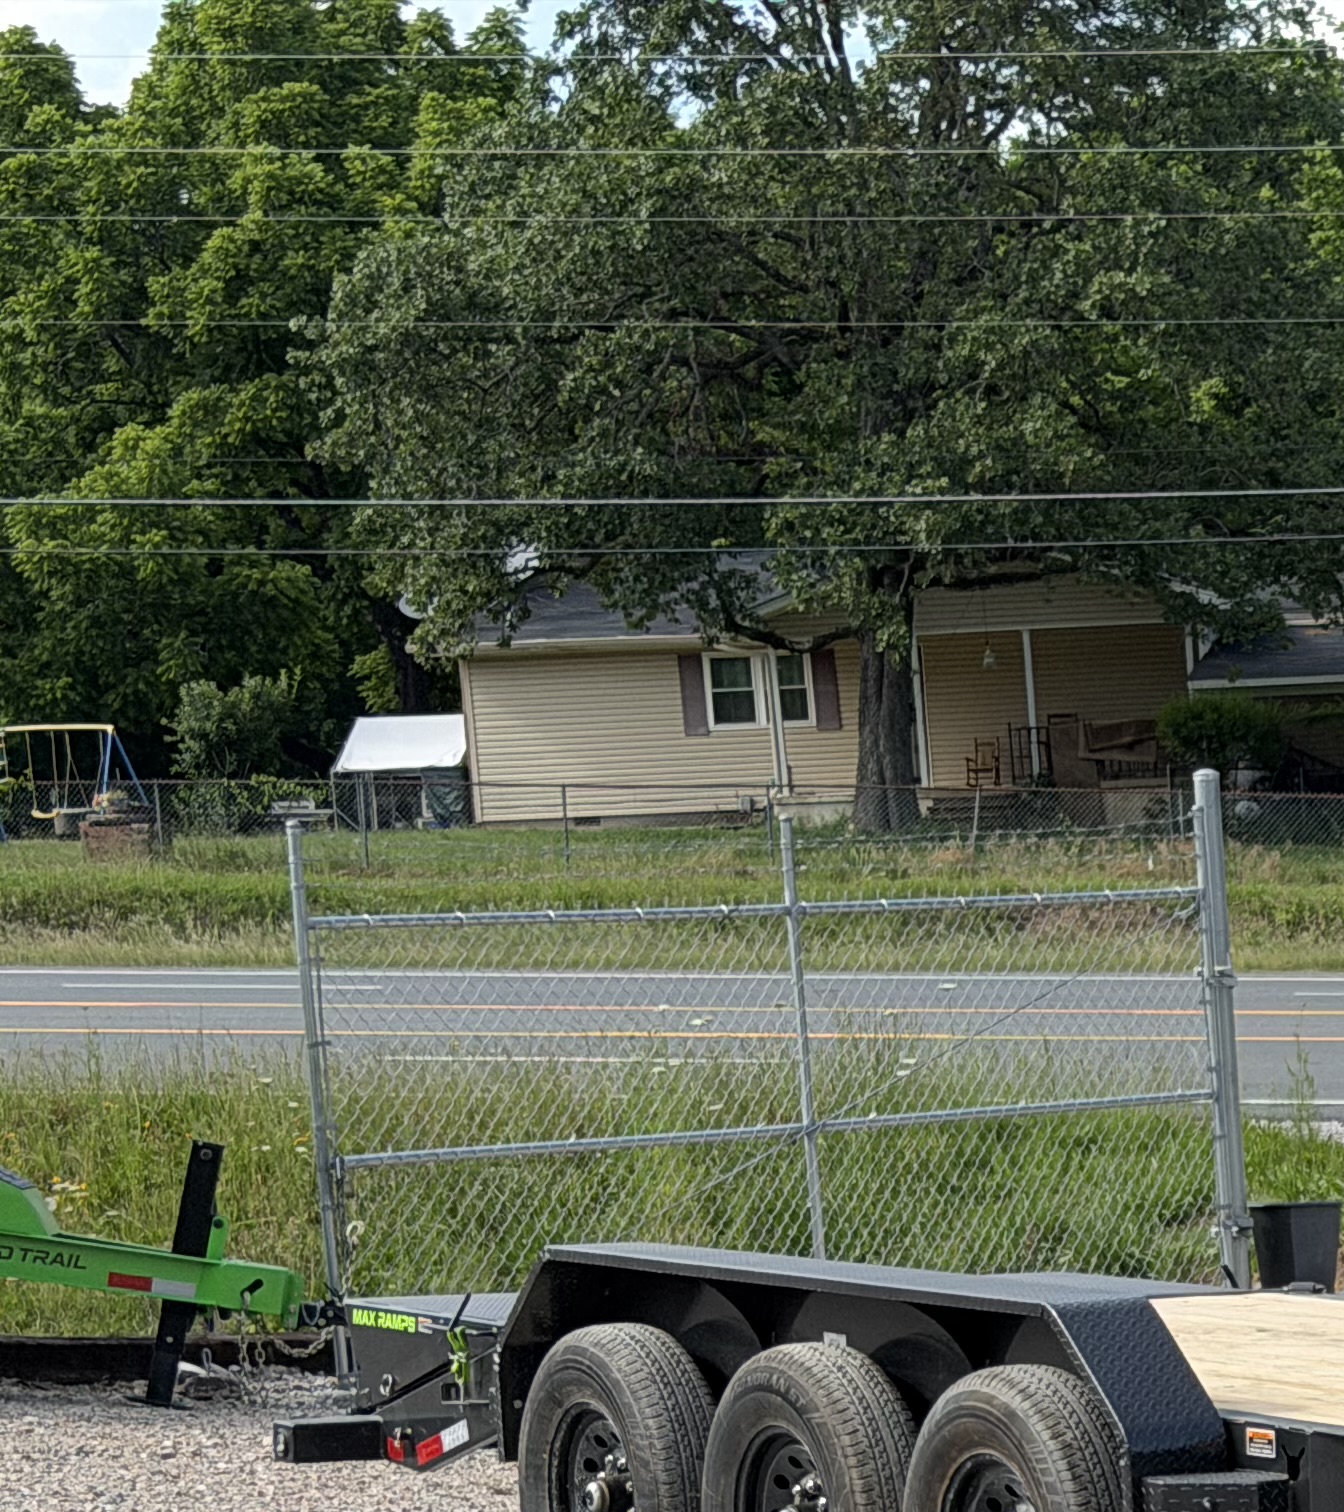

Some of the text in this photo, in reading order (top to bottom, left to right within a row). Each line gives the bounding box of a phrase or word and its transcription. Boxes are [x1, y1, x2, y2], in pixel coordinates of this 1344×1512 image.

[20, 1247, 87, 1270] TRAIL
[352, 1308, 416, 1333] MAX RAMPS
